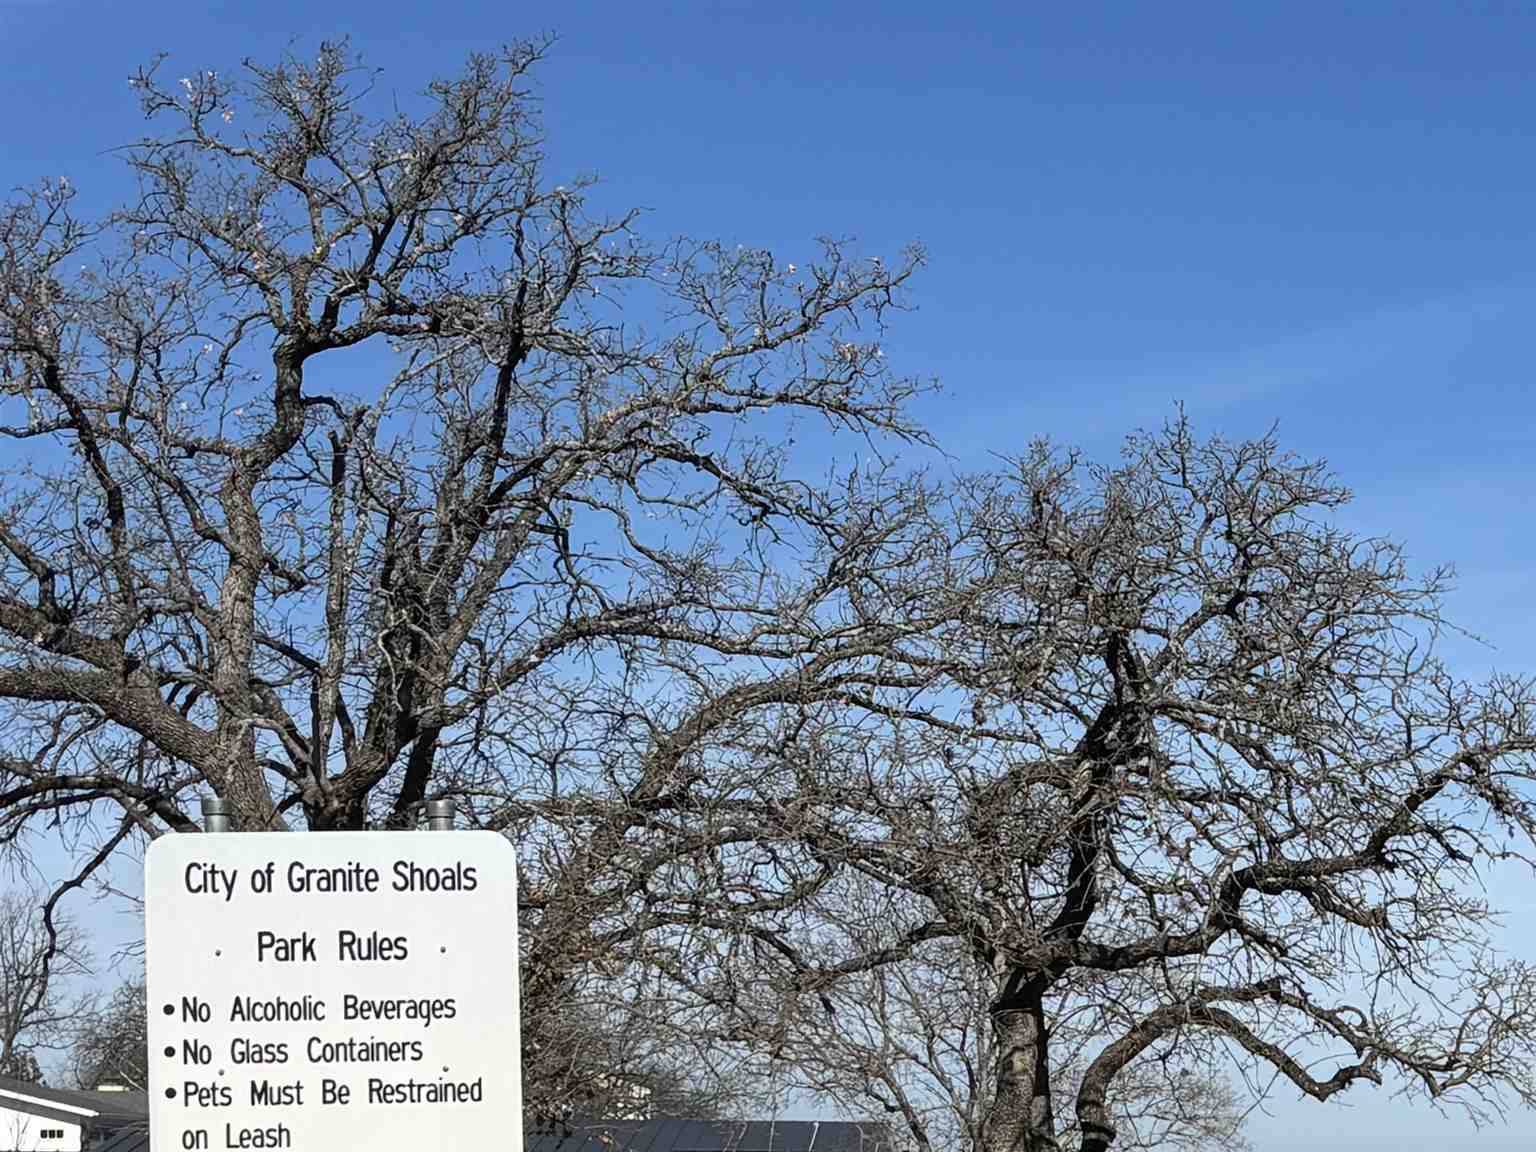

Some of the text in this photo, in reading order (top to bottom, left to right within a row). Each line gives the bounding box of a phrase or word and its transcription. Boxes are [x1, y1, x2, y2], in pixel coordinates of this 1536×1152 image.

[185, 861, 477, 901] City of Granite Shoals
[258, 931, 407, 961] Park Rules
[183, 995, 456, 1027] No Alcoholic Beverages
[184, 1037, 422, 1064] No Glass Containers
[185, 1078, 482, 1107] Pets Must Be Restrained
[183, 1124, 290, 1149] on Leash
